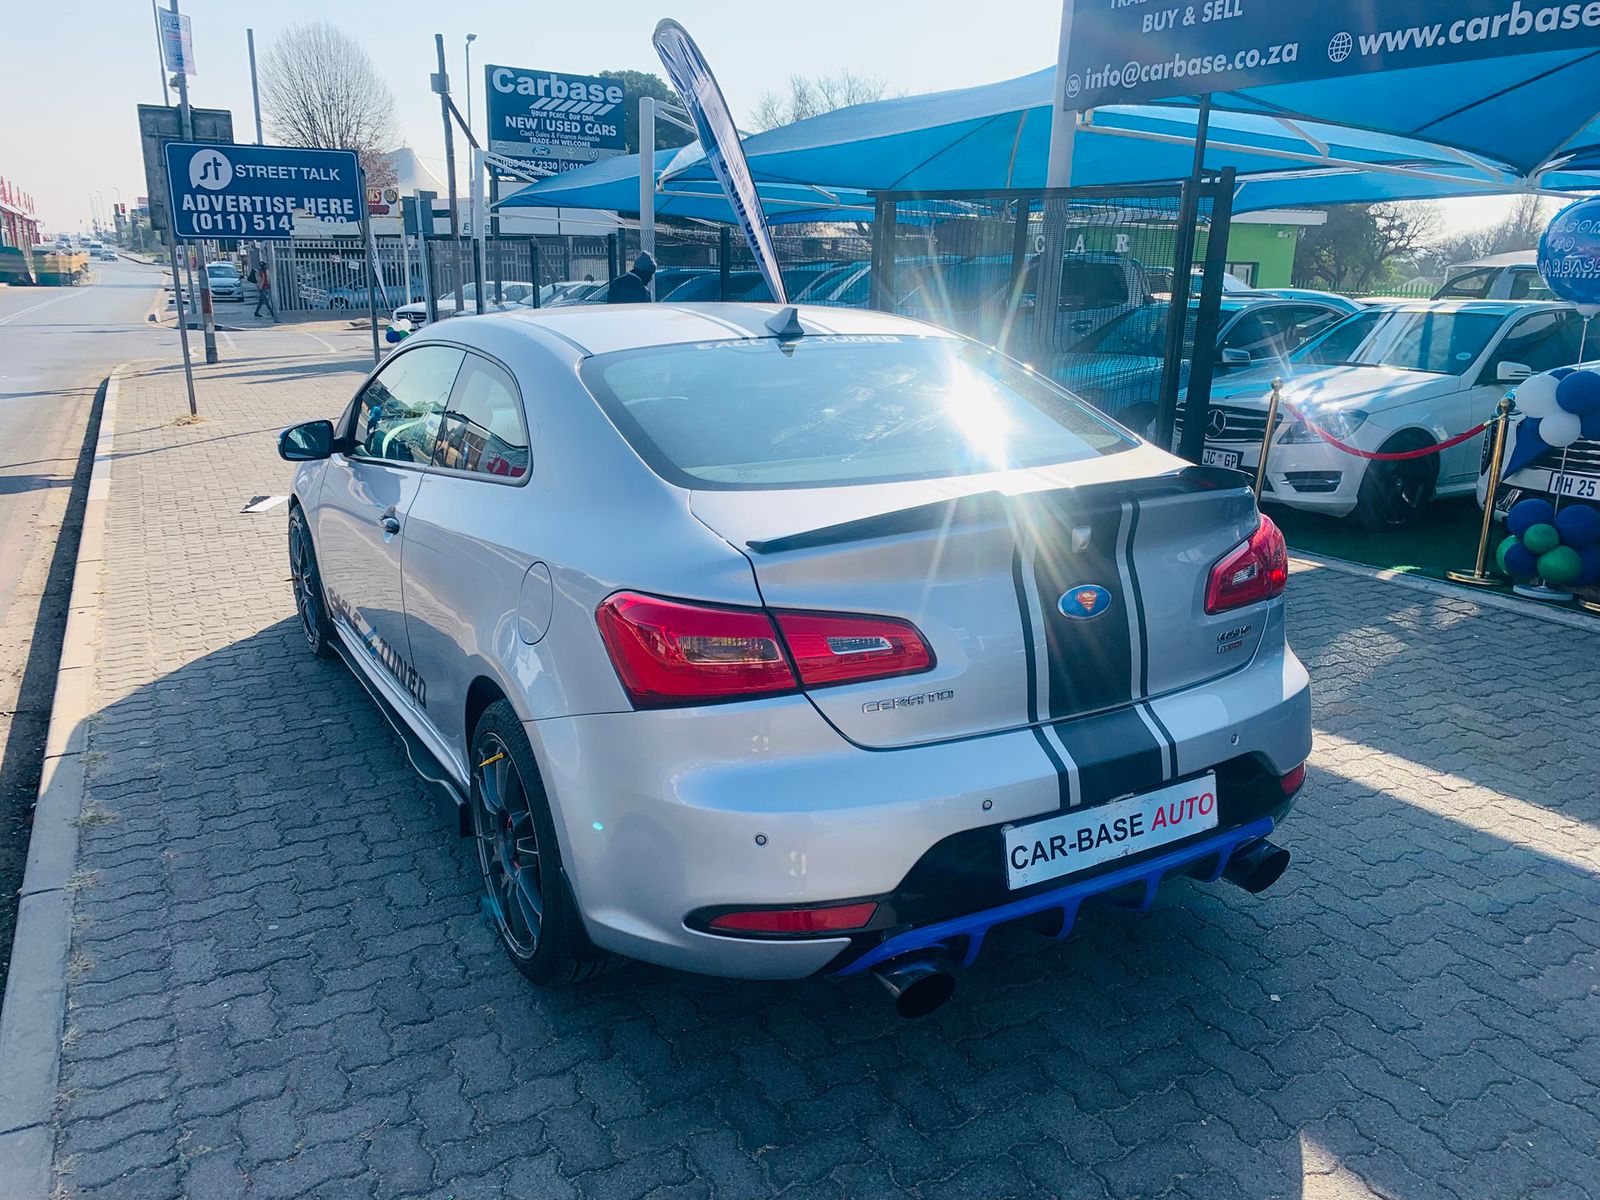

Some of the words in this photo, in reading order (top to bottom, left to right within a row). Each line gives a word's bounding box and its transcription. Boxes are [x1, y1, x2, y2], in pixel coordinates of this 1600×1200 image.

[1142, 11, 1179, 33] BUY
[1182, 6, 1196, 26] &
[1202, 0, 1243, 23] SELL
[1085, 42, 1299, 89] info@carbase.co.za
[492, 68, 623, 104] Carbase
[505, 116, 538, 130] NEW
[546, 119, 580, 133] USED
[585, 123, 617, 136] CARS
[529, 137, 560, 146] TRADE-IN
[560, 138, 591, 148] WELCOME
[236, 164, 297, 180] STREET
[300, 167, 341, 181] TALK
[538, 161, 557, 170] 2330
[182, 193, 297, 214] ADVERTISE
[304, 197, 354, 215] HERE
[192, 212, 247, 234] (011)
[1224, 454, 1237, 468] GP
[1576, 479, 1597, 497] 25
[862, 688, 954, 713] CERATO
[1010, 812, 1145, 870] CAR-BASE
[1151, 792, 1214, 831] AUTO
